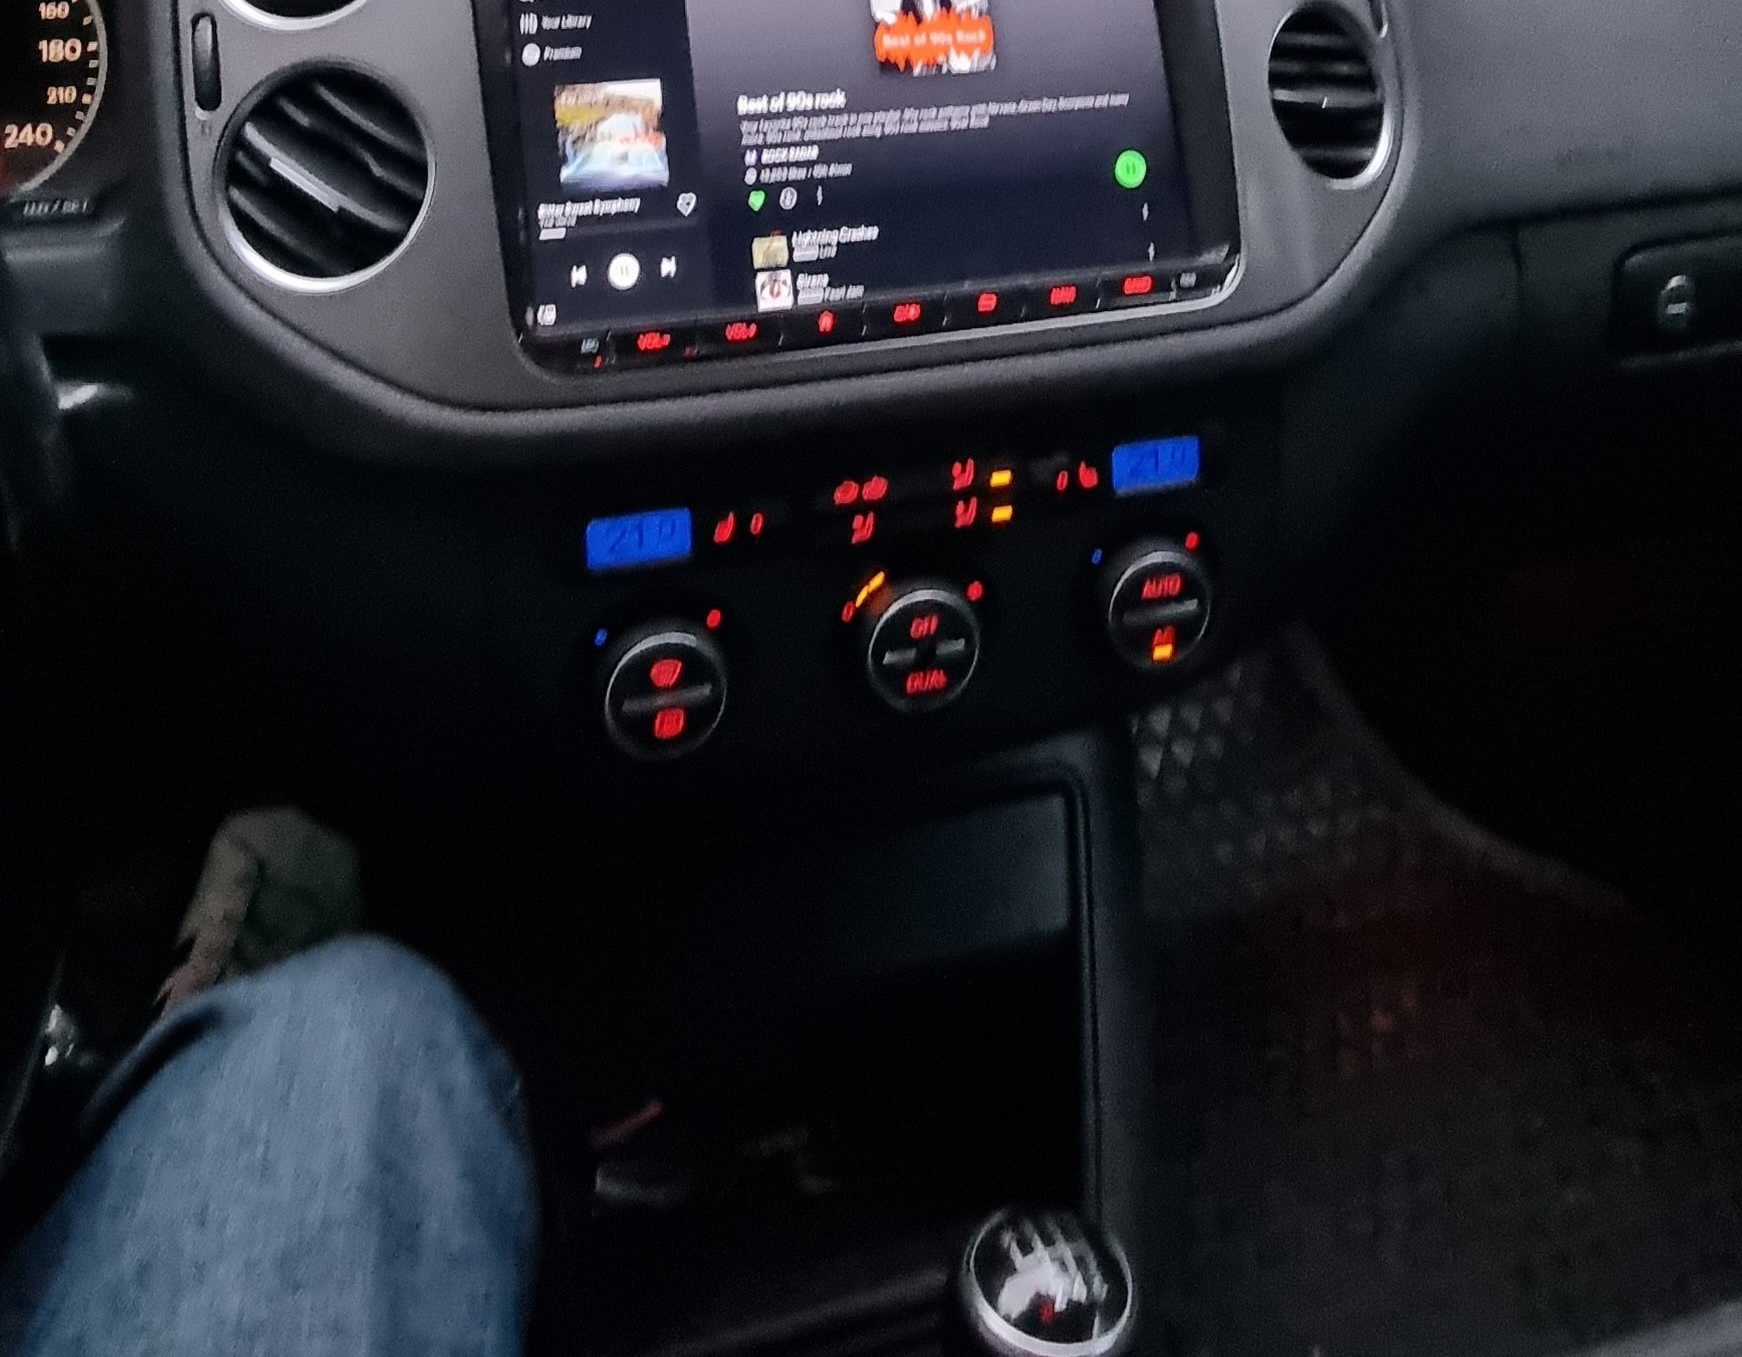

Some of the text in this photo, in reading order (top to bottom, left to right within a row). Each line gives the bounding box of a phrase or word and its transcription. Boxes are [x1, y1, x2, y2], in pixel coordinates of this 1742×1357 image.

[38, 39, 82, 63] 180
[737, 88, 847, 115] Best of 90s rock
[5, 123, 54, 149] 240
[593, 197, 641, 217] Symphony
[792, 228, 838, 246] Lightning
[1141, 574, 1182, 600] AUTO
